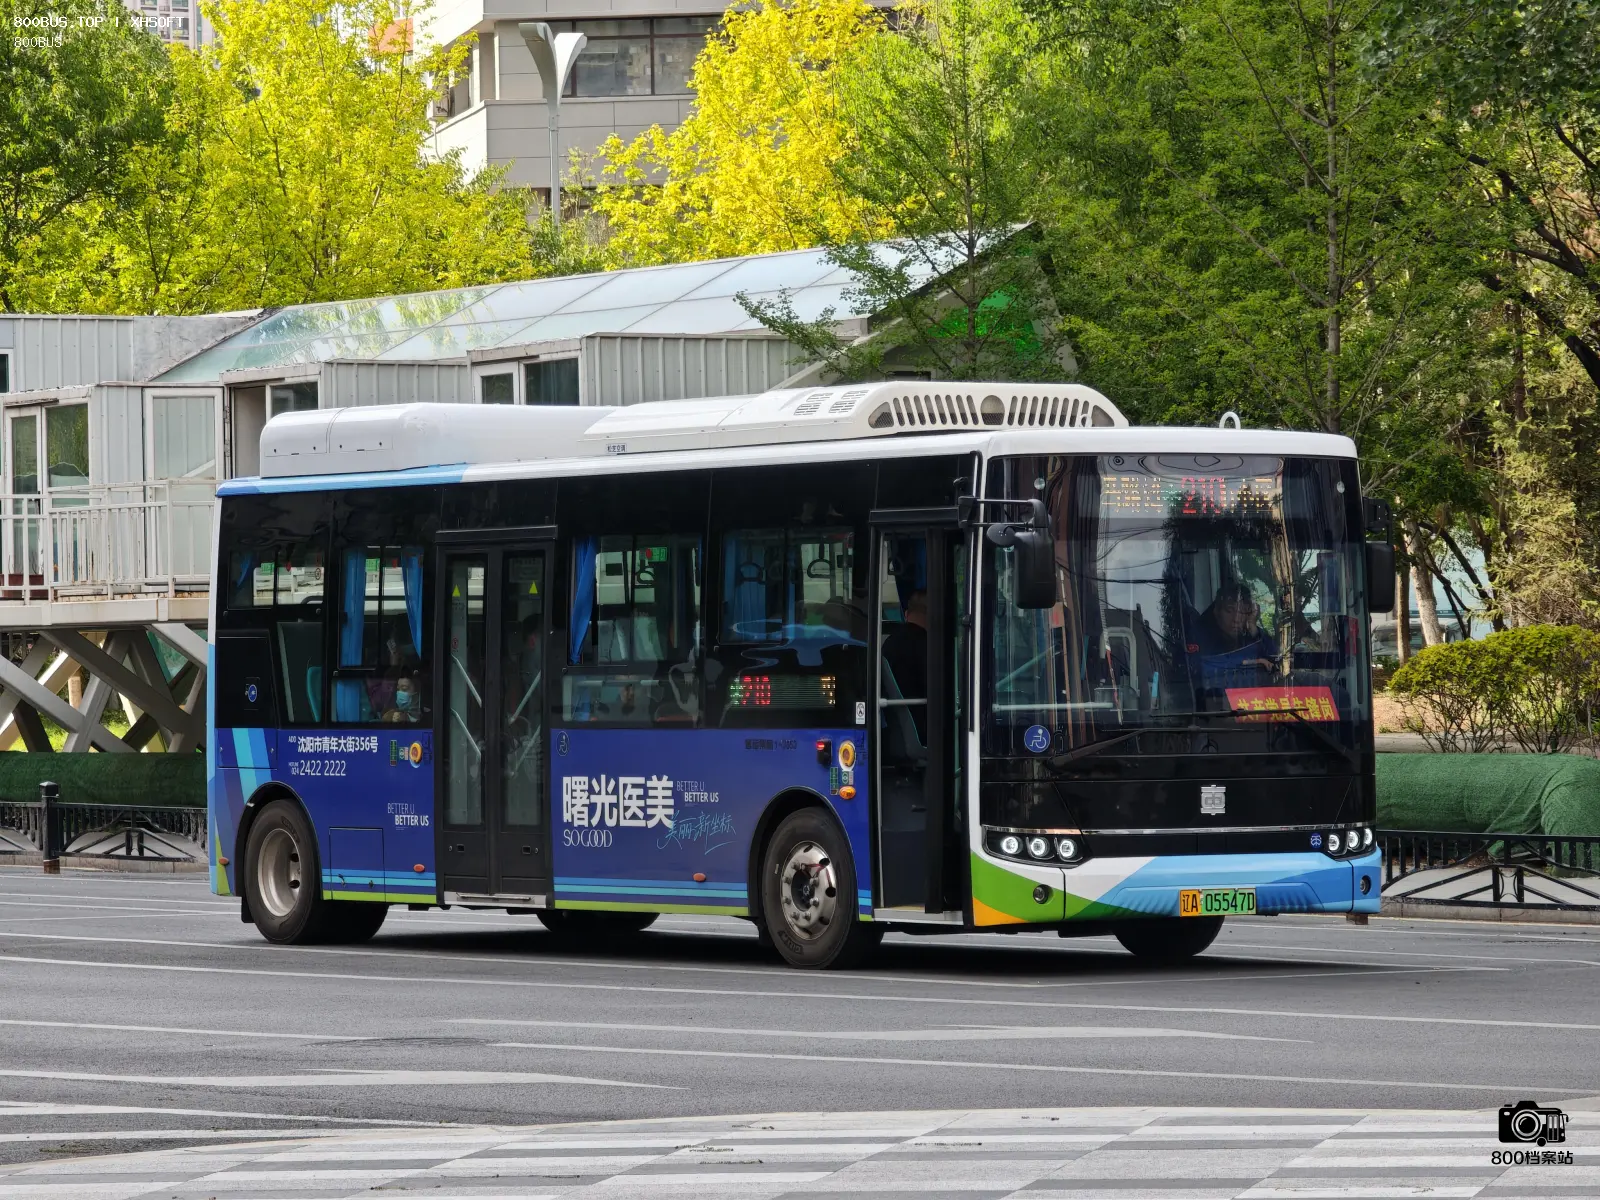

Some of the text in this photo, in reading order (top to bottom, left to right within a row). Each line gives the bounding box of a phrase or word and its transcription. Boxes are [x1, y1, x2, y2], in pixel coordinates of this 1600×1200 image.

[297, 735, 379, 753] 沈阳市青年大街356号
[300, 760, 322, 776] 2422
[324, 760, 347, 777] 2222
[676, 780, 699, 792] BETTER
[562, 774, 675, 829] 曙光医美
[684, 792, 720, 803] BETTER US
[387, 802, 409, 815] BETTER
[394, 815, 430, 827] BETTER US
[1182, 892, 1255, 913] 辽A 05547D
